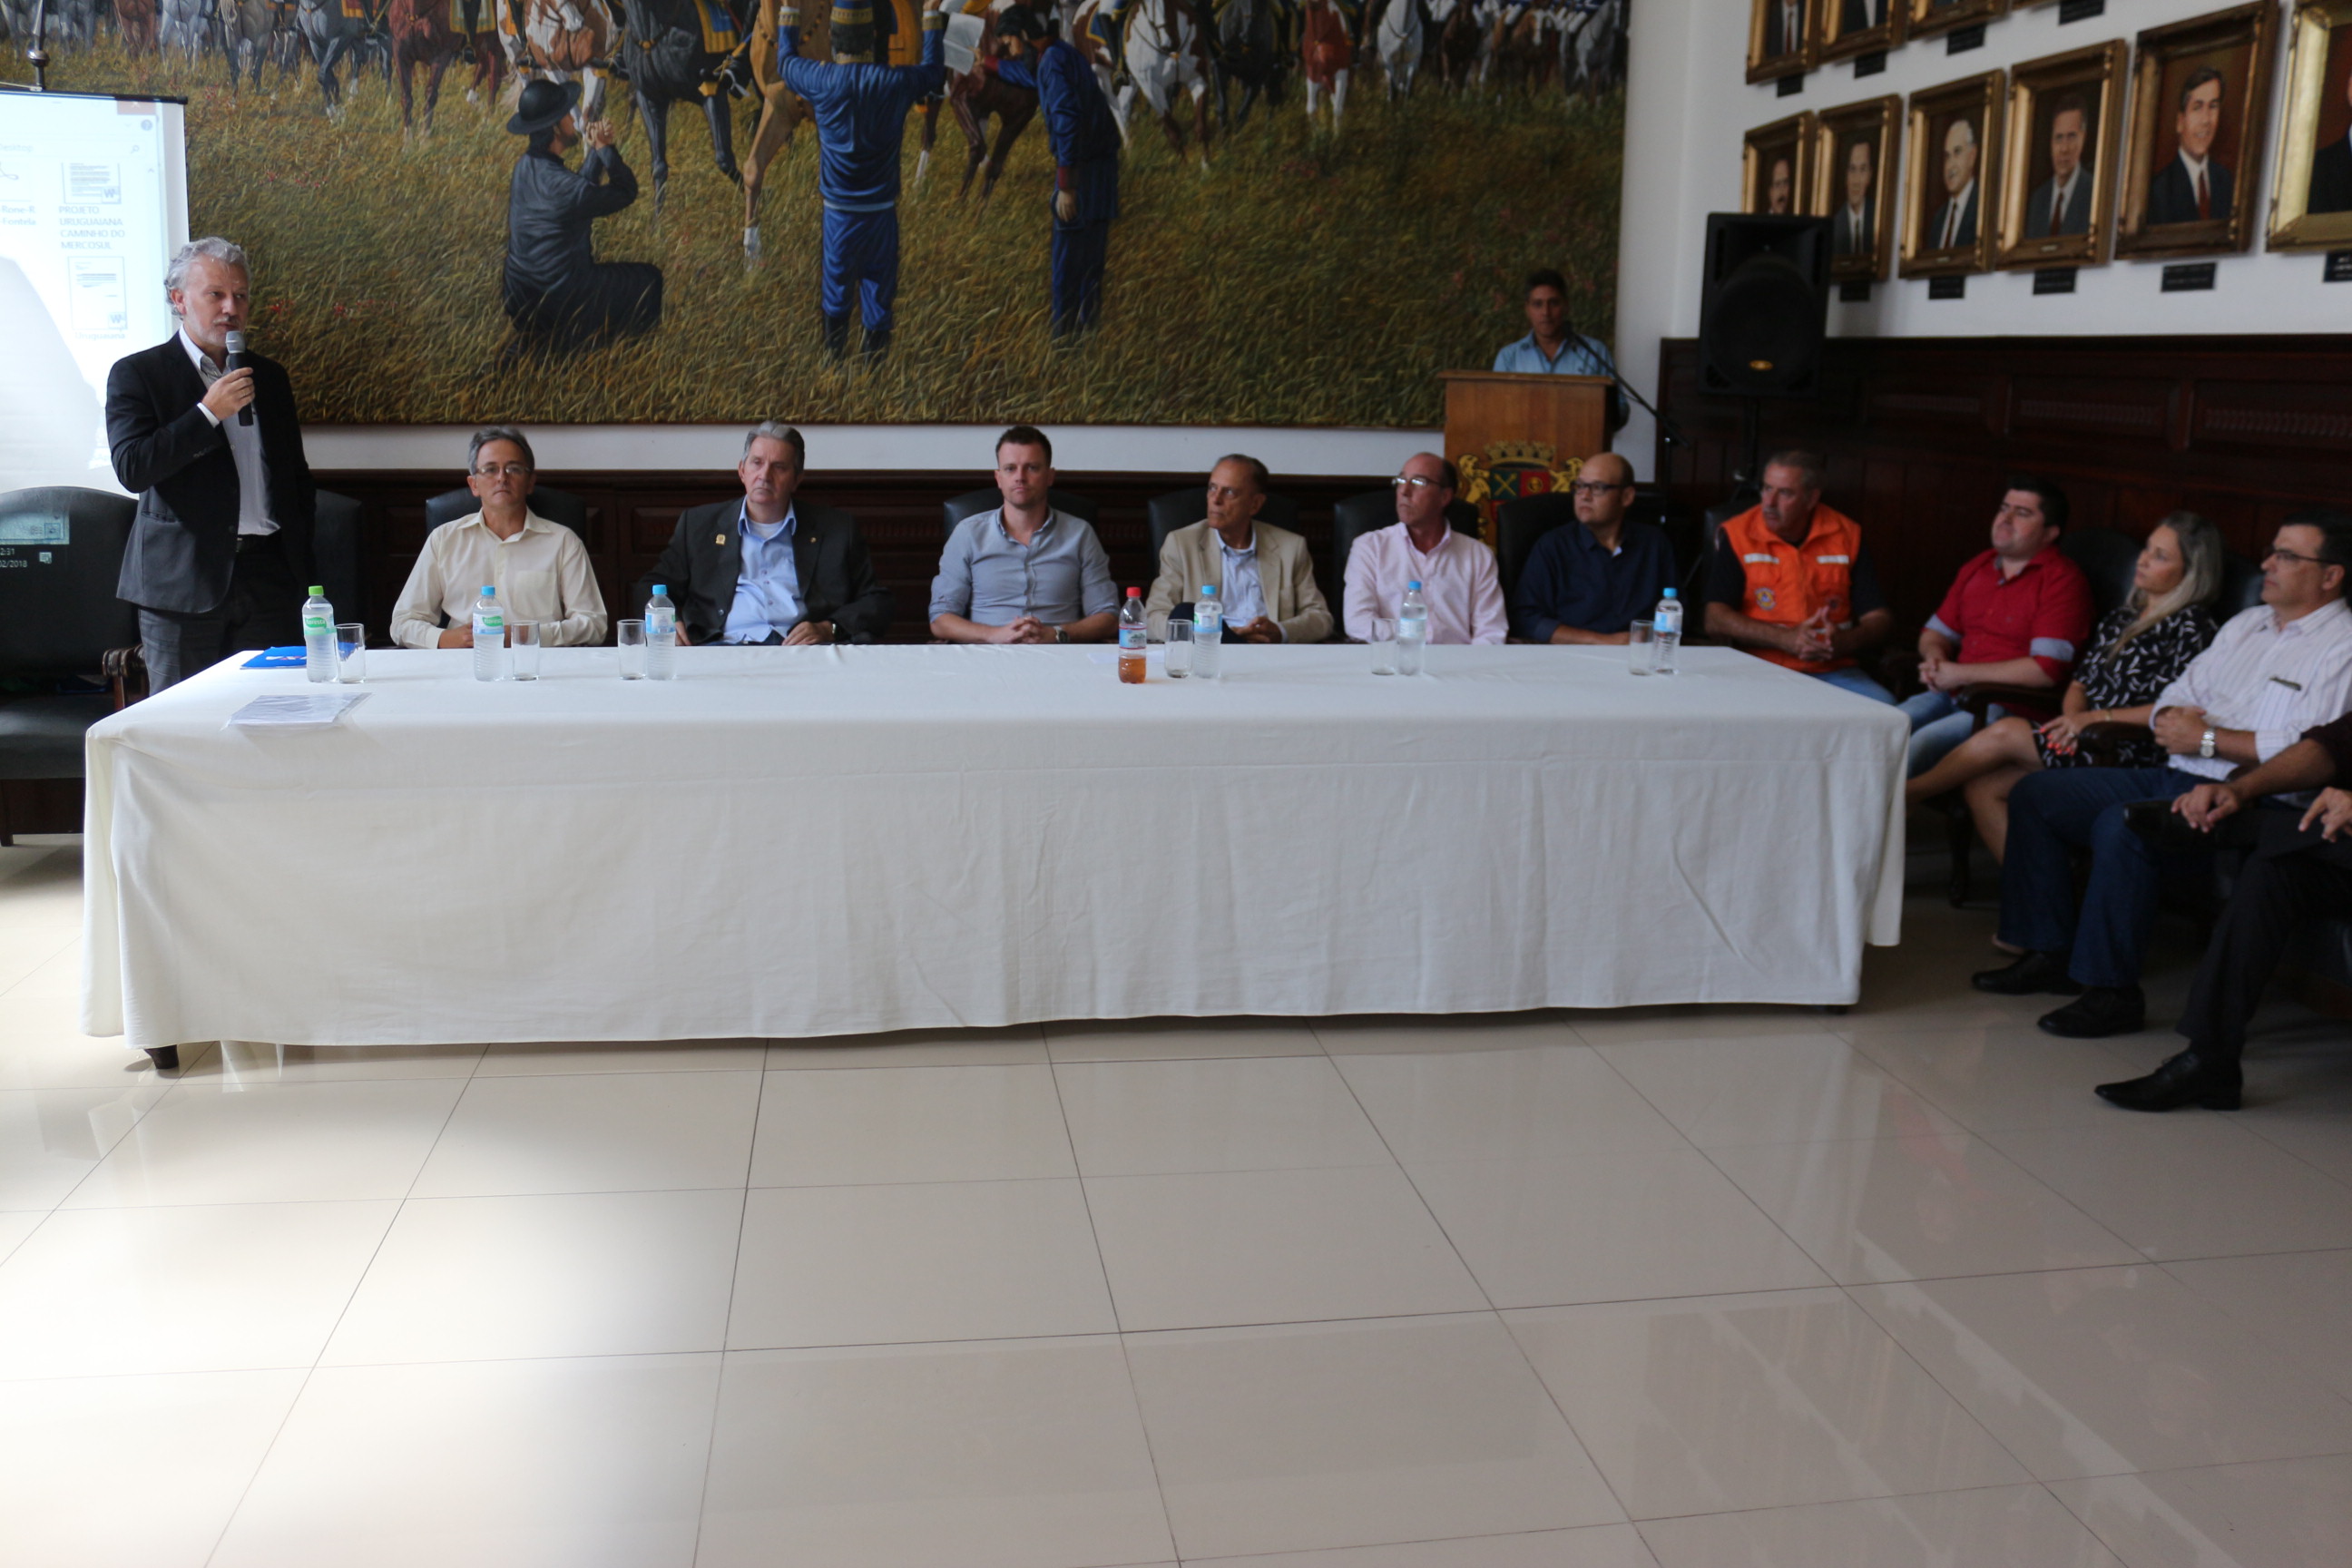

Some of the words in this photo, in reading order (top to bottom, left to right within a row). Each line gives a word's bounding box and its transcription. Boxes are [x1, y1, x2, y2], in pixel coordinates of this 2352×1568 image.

[58, 205, 100, 214] PROJETO
[59, 217, 123, 226] URUGUAIANA
[60, 229, 109, 238] CAMINHO
[111, 229, 125, 238] DO
[61, 240, 112, 250] MERCOSUL
